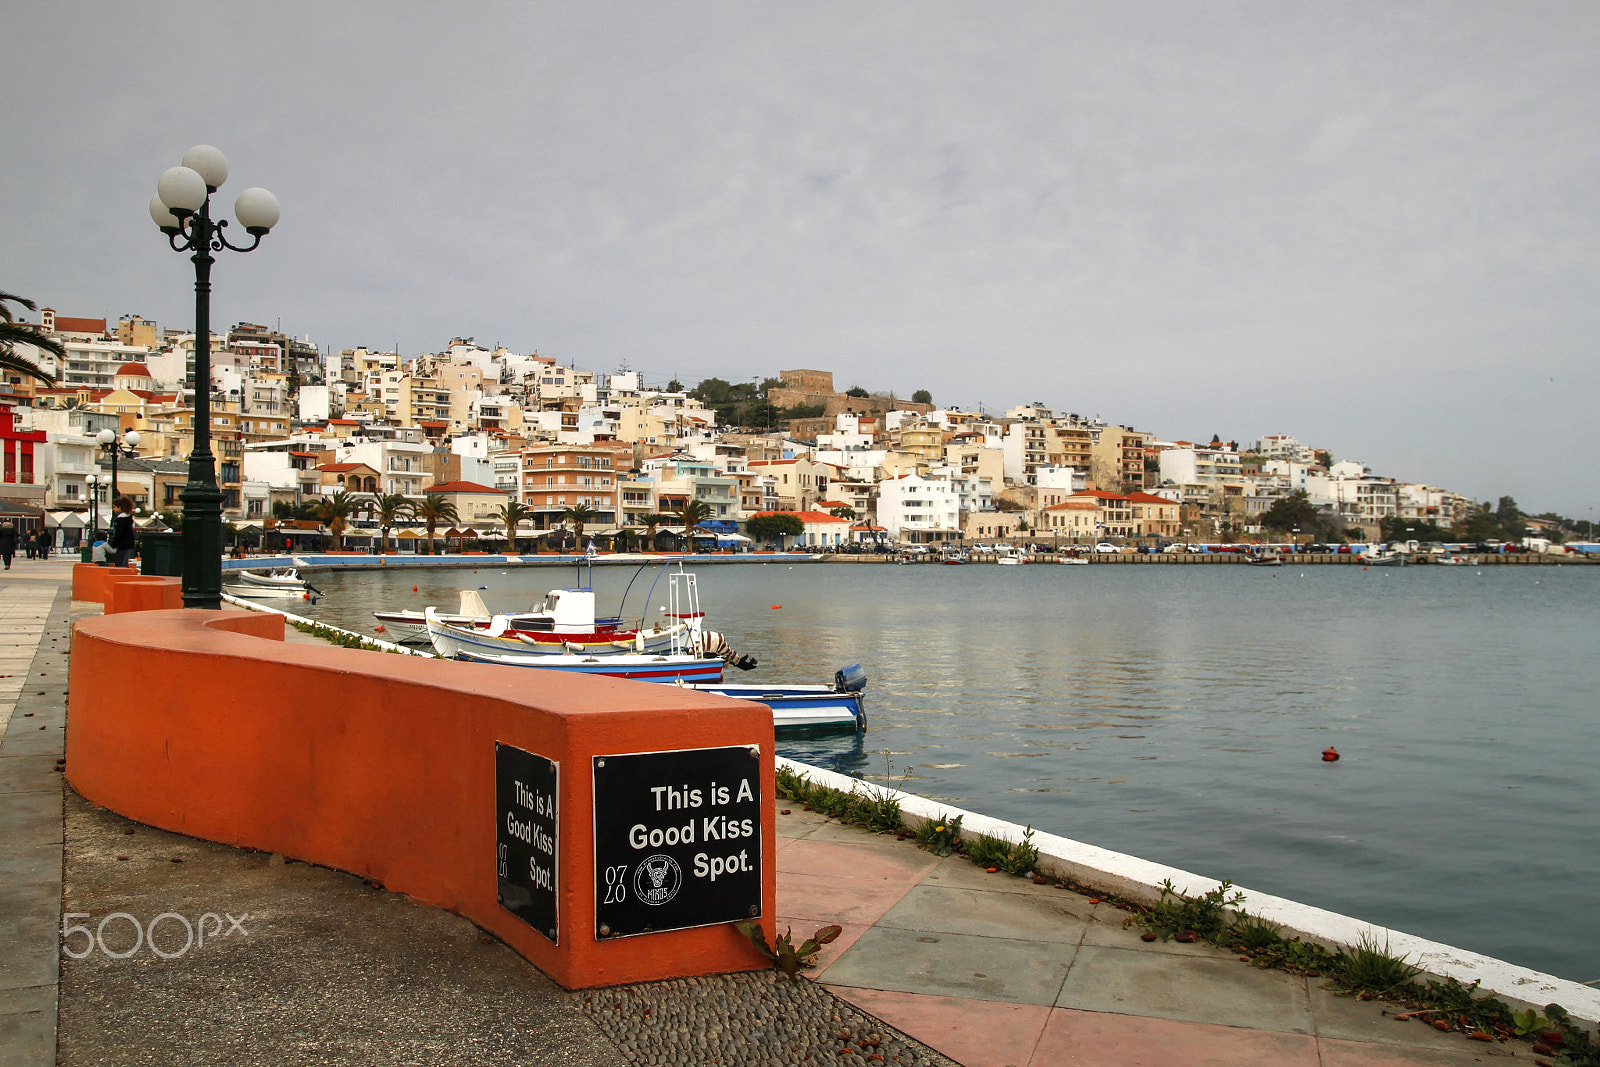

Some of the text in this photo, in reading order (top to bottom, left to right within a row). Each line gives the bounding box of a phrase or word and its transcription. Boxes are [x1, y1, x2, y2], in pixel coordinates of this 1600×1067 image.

[514, 780, 554, 820] This is A
[650, 778, 754, 811] This is A
[507, 811, 553, 855] Good Kiss
[629, 815, 754, 849] Good Kiss
[529, 856, 553, 892] Spot.
[605, 865, 628, 884] 07
[693, 848, 754, 882] Spot.
